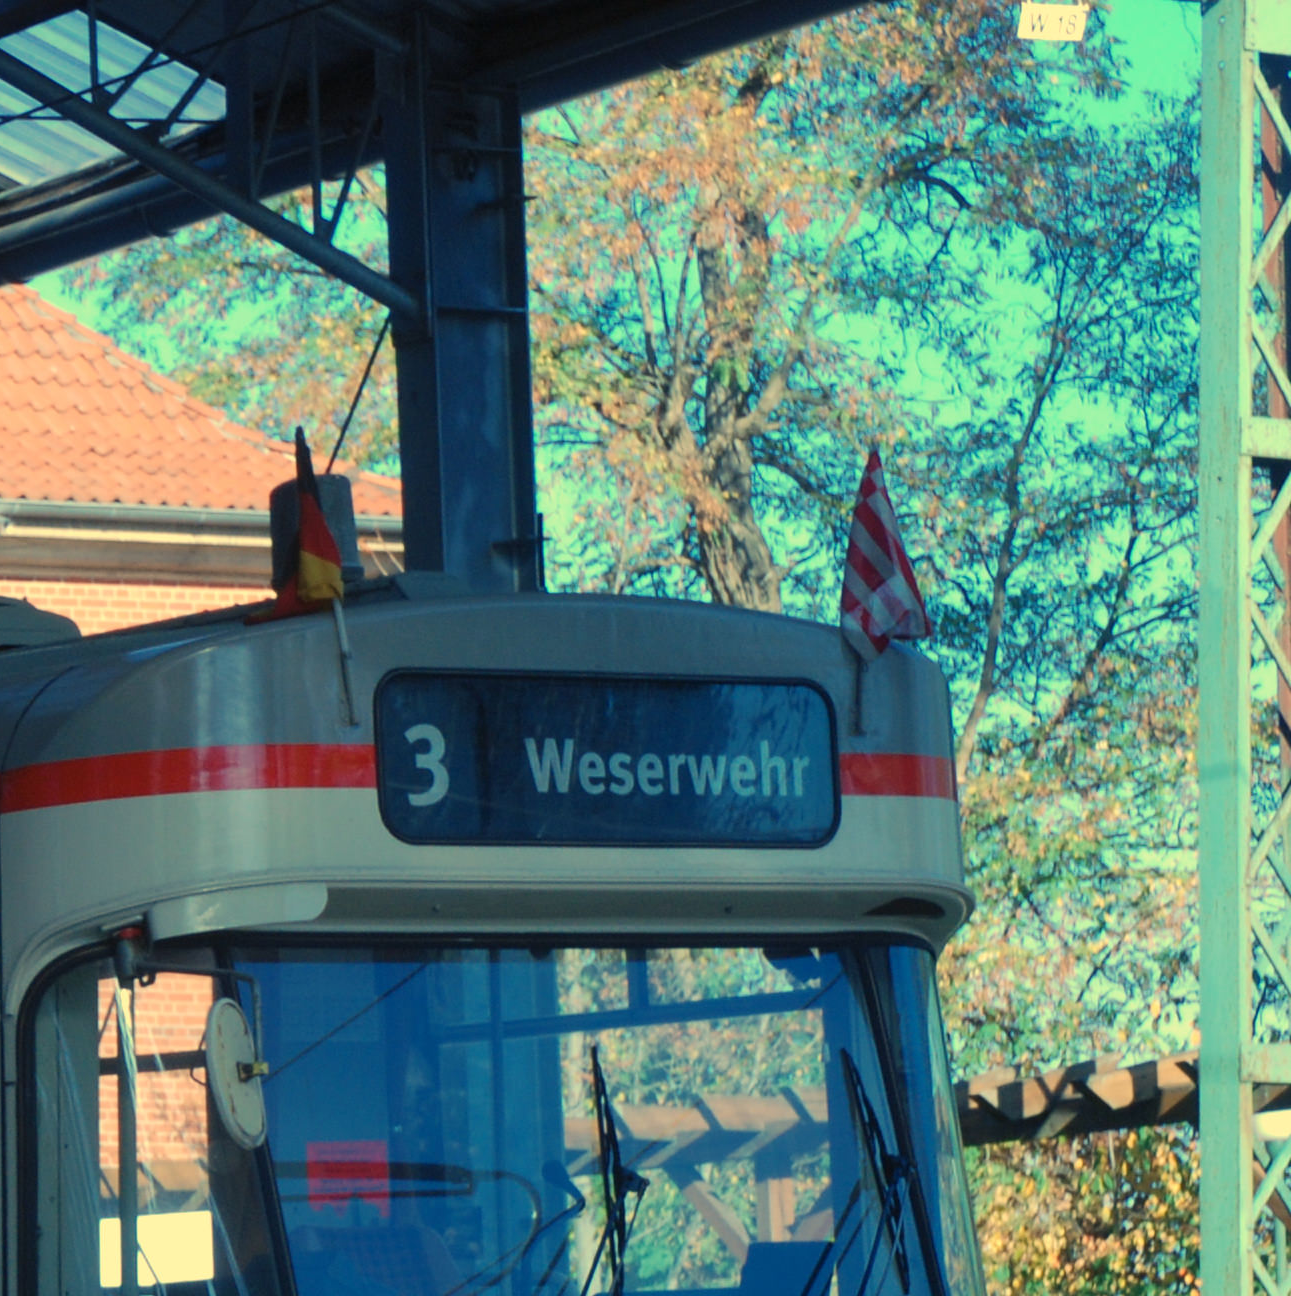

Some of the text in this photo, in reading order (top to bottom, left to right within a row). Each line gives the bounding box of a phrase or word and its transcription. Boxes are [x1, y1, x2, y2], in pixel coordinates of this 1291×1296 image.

[1030, 13, 1049, 32] W
[402, 723, 810, 808] 3 Weserwehr
